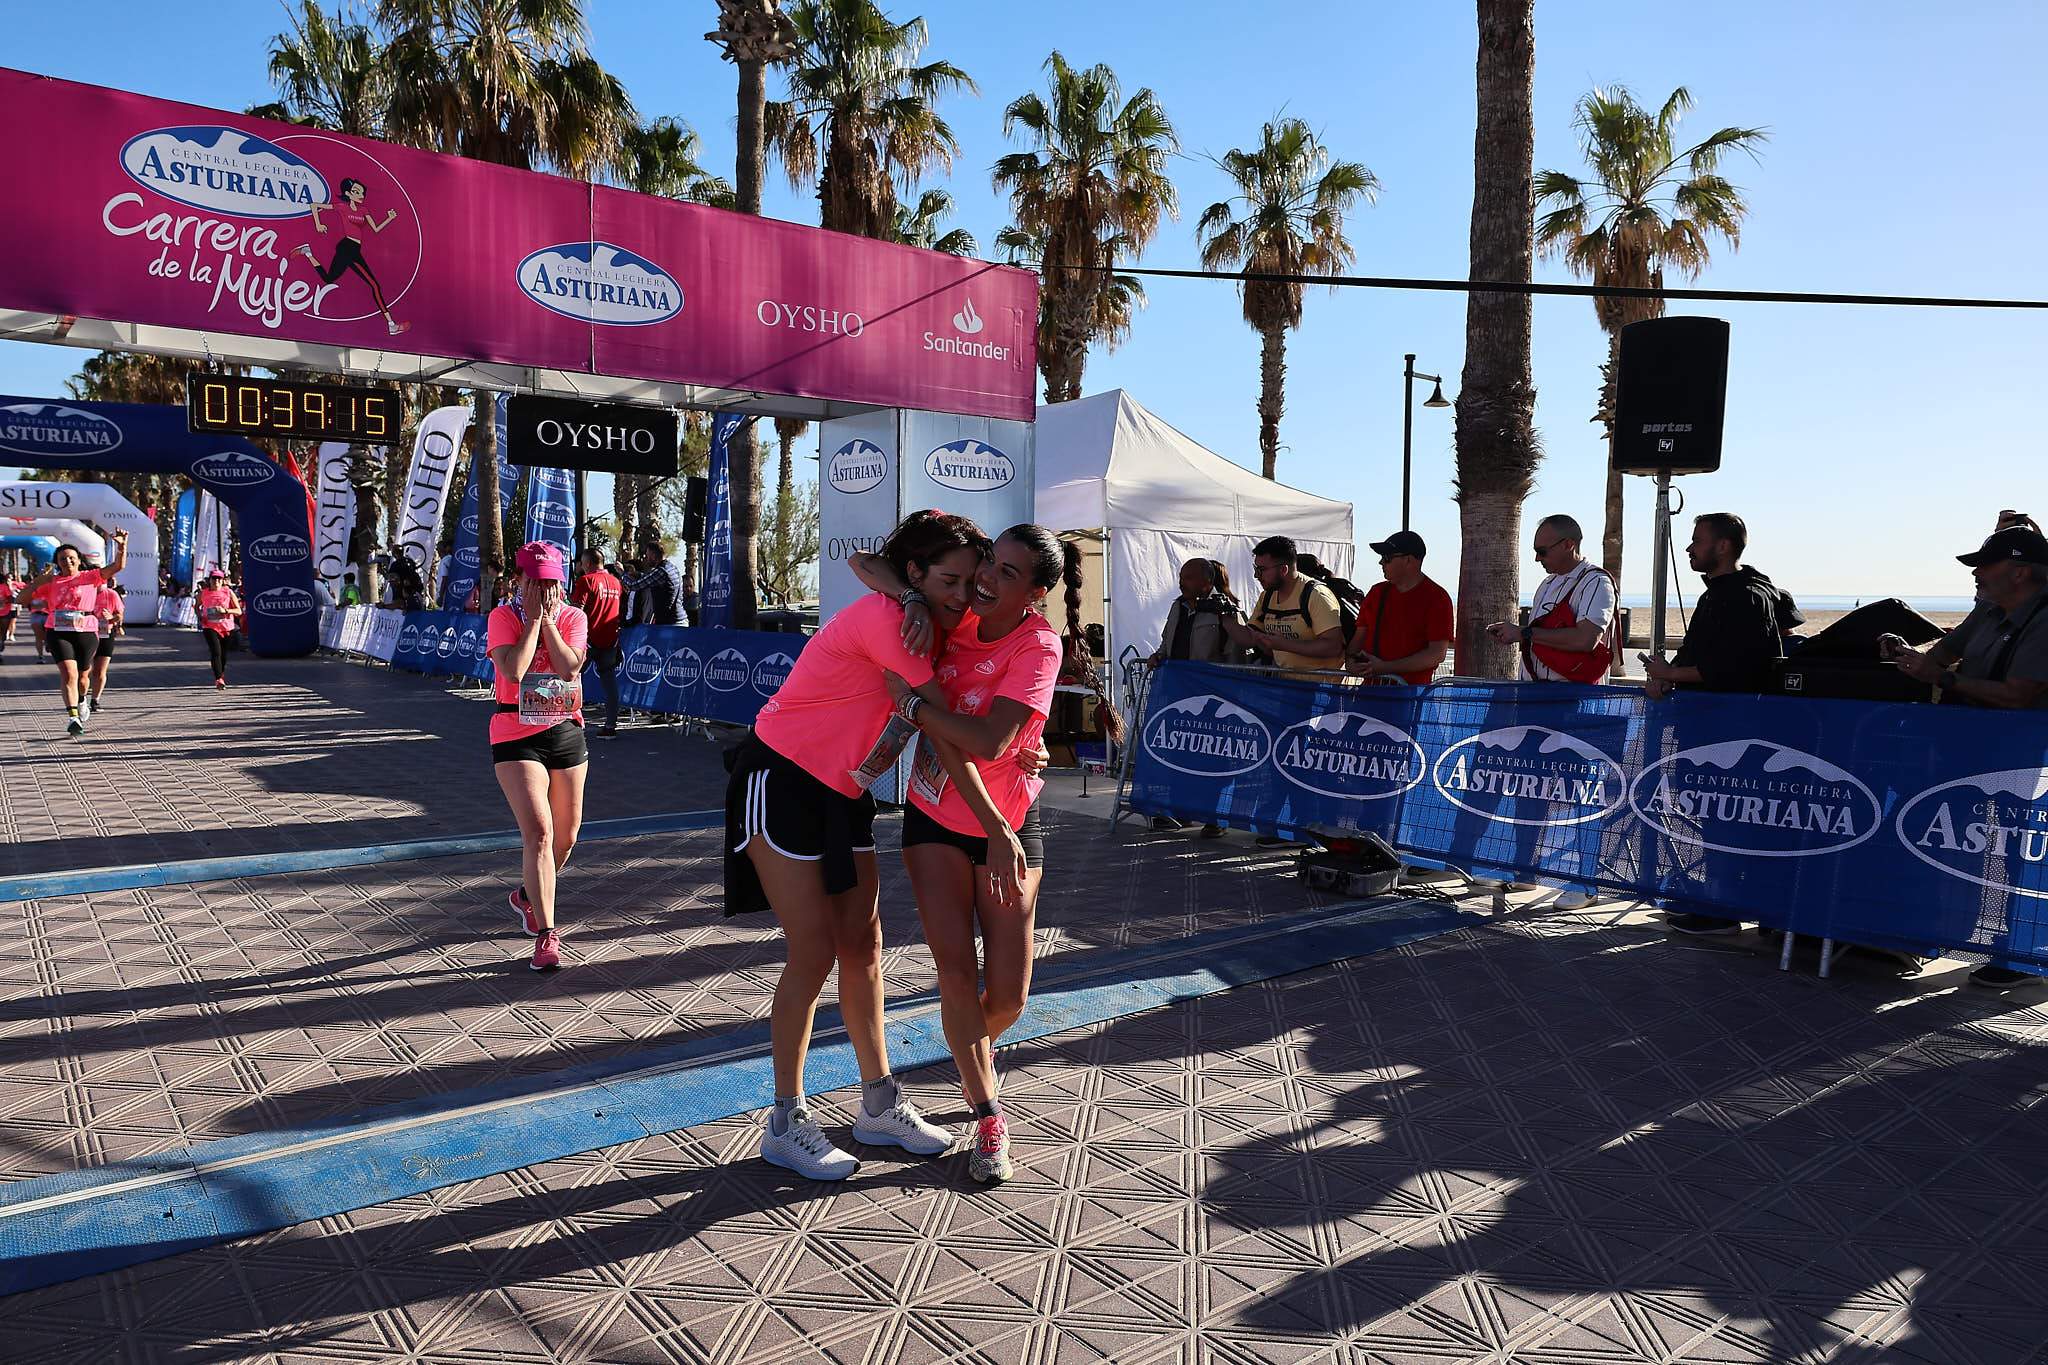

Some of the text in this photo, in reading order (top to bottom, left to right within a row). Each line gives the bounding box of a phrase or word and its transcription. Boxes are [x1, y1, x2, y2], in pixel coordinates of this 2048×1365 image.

[138, 145, 315, 206] ASTURIANA
[171, 147, 309, 181] CENTRAL LECHERA
[102, 192, 279, 260] Carrera
[148, 246, 340, 329] de la Mujer
[530, 263, 672, 311] ASTURIANA
[556, 263, 667, 289] CENTRAL LECHERA
[757, 299, 865, 338] OYSHO
[922, 331, 1010, 362] Santander
[204, 383, 385, 435] 00:39:15
[536, 419, 656, 454] OYSHO
[1642, 422, 1693, 434] portas
[199, 463, 270, 478] ASTURIANA
[832, 462, 883, 482] ASTURIANA
[931, 455, 1008, 481] ASTURIANA
[1, 487, 71, 510] SHO
[318, 457, 350, 580] OYSHO
[706, 665, 746, 683] ASTURIANA
[1150, 719, 1260, 762] ASTURIANA
[1172, 718, 1259, 738] CENTRAL LECHERA
[1306, 735, 1410, 755] CENTRAL LECHERA
[1280, 735, 1412, 783] ASTURIANA
[1476, 753, 1606, 777] CENTRAL LECHERA
[1443, 753, 1609, 807] ASTURIANA
[1684, 772, 1853, 801] CENTRAL LECHERA
[1643, 773, 1858, 837] ASTURIANA
[1972, 803, 2048, 823] CENTR
[1916, 801, 2048, 863] ASTU
